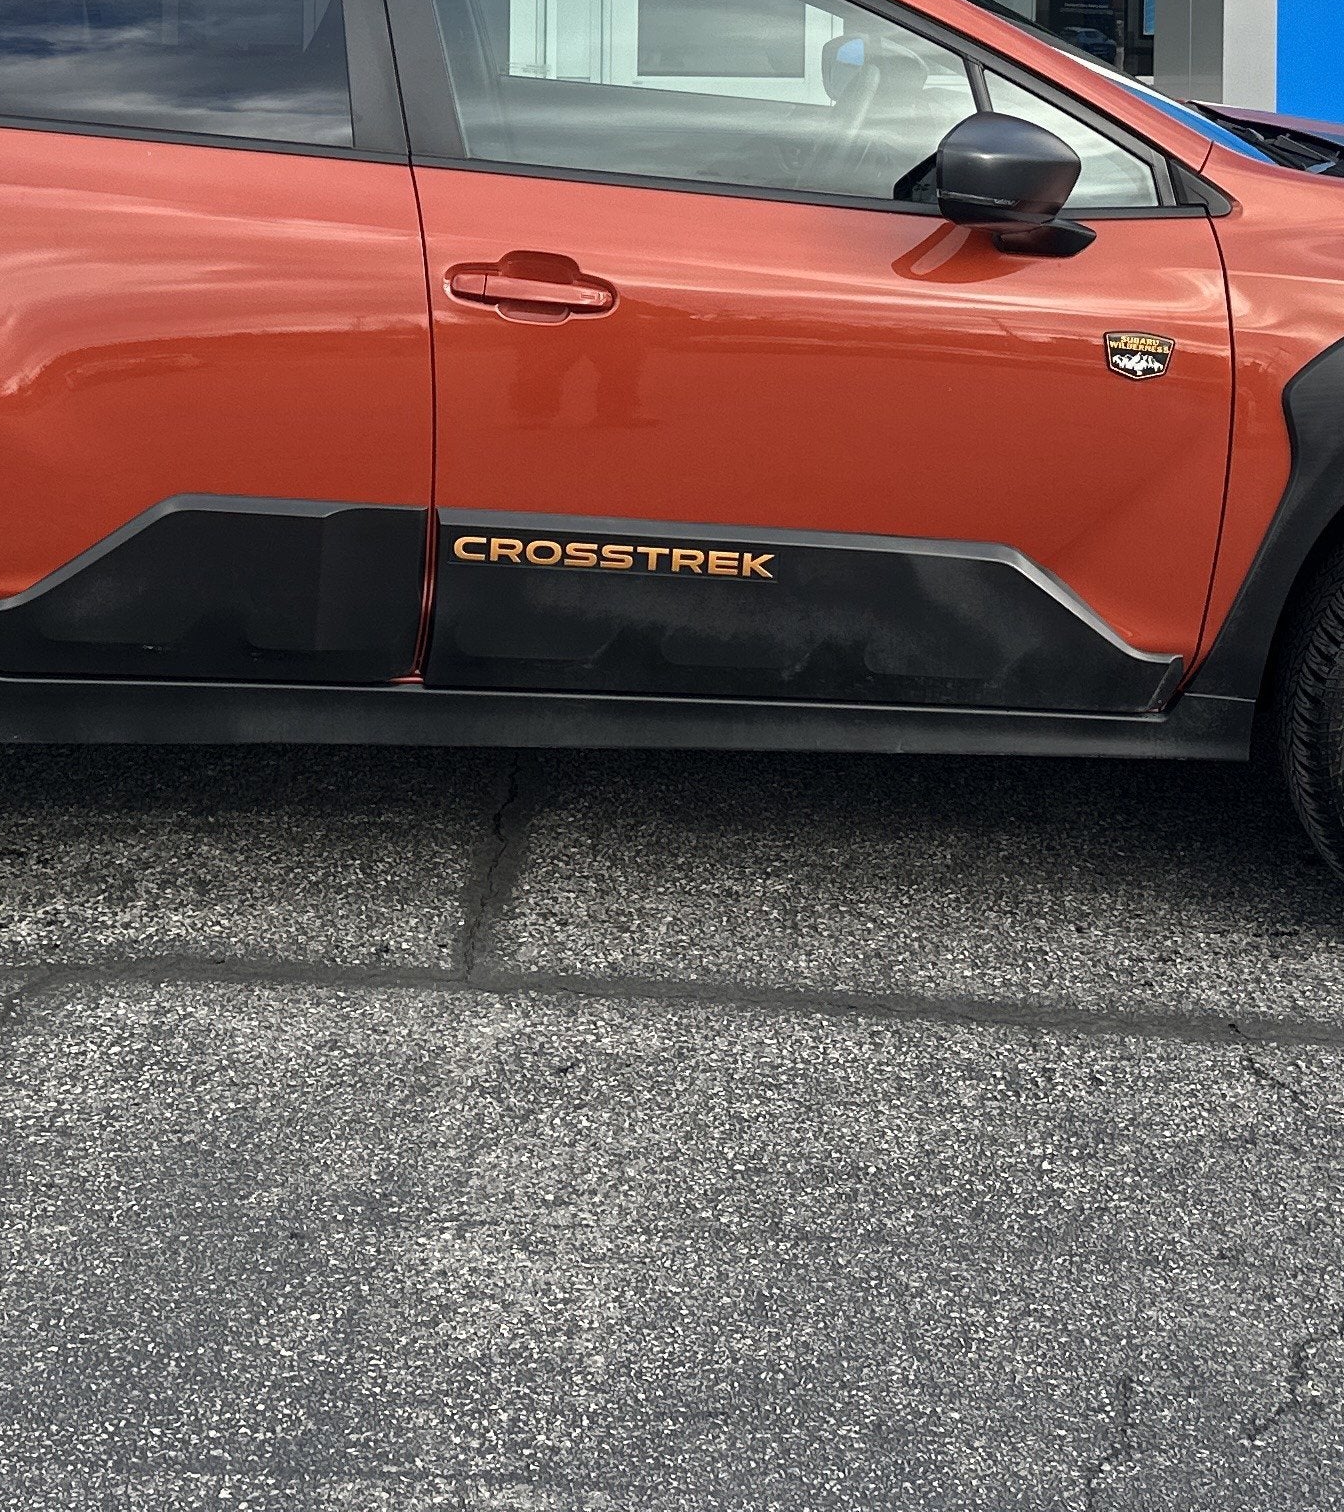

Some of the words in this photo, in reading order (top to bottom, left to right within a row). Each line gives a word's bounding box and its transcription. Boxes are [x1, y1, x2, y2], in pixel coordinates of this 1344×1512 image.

[1109, 340, 1170, 354] WILDERNESS
[1120, 335, 1160, 346] SUBARU
[453, 536, 776, 579] CROSSTREK
